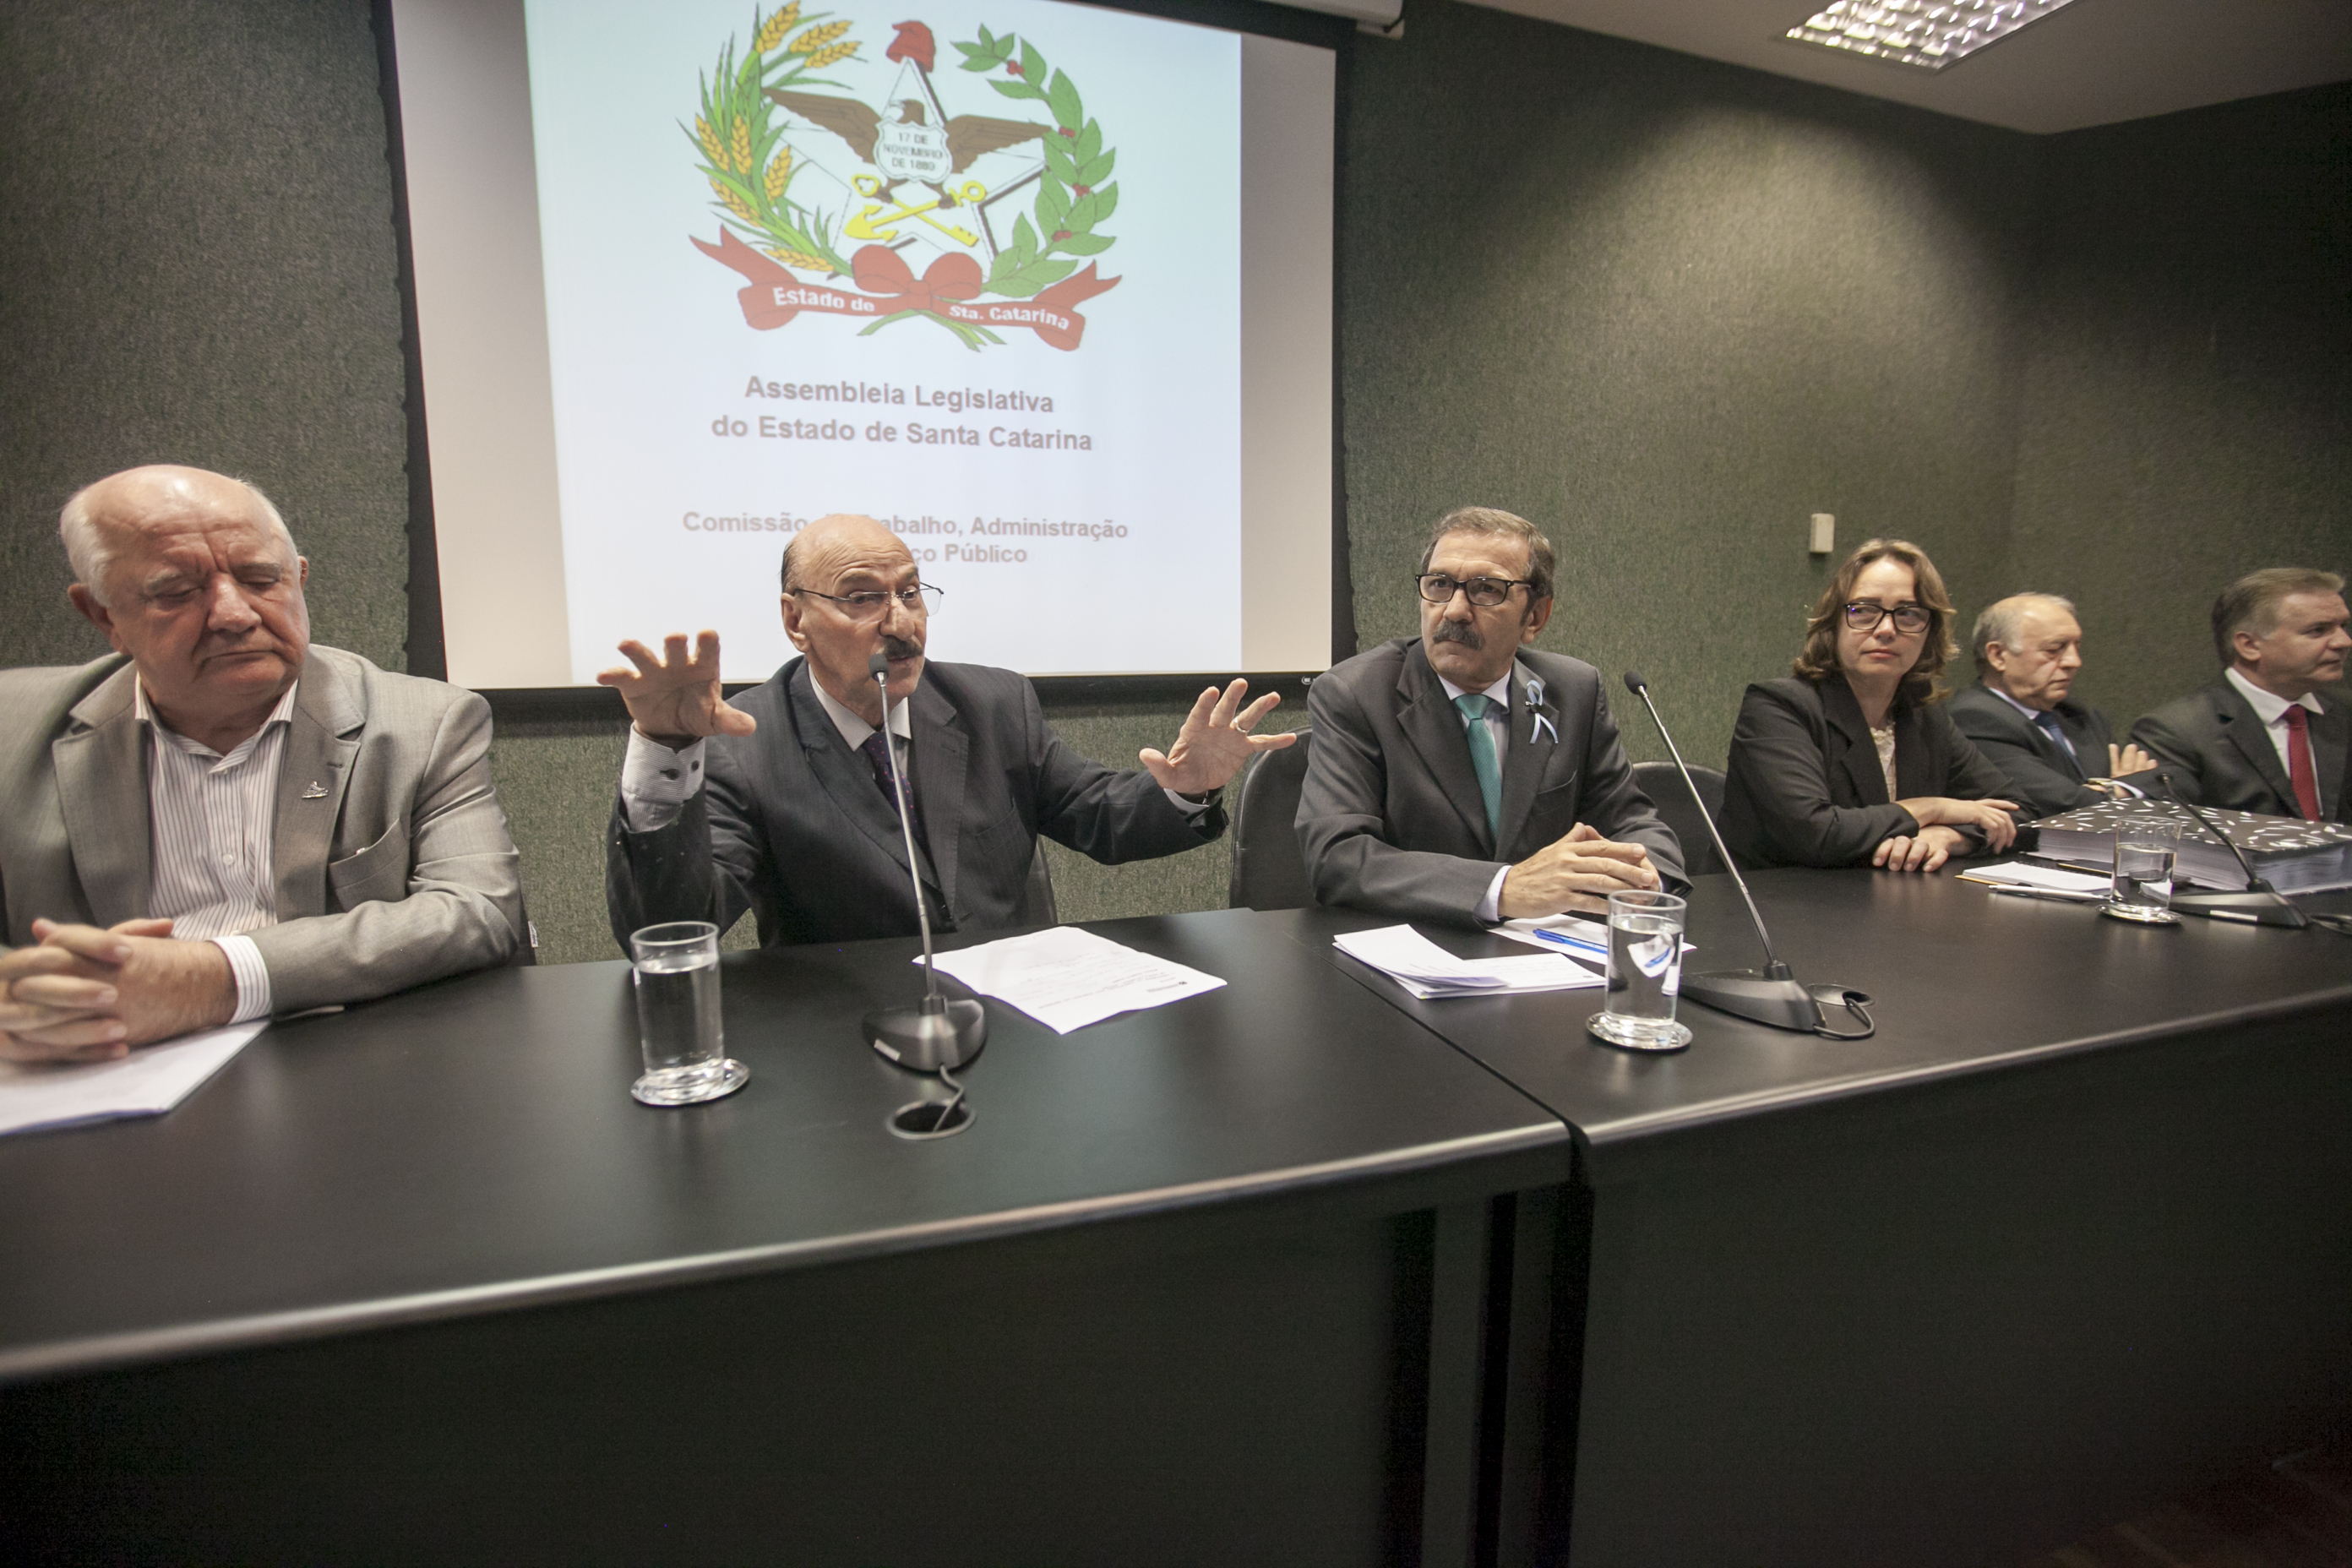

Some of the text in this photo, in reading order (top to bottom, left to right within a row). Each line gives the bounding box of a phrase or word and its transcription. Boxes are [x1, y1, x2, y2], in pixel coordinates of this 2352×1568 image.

[914, 133, 928, 145] DE
[892, 157, 906, 169] DE
[772, 286, 874, 313] Estado de
[949, 305, 1070, 331] Sta. Catarina
[744, 375, 1054, 413] Assembleia Legislativa
[711, 415, 1092, 450] do Estado de Santa Catarina
[683, 511, 1128, 542] Comissão abalho, Administração
[945, 542, 1027, 563] Público
